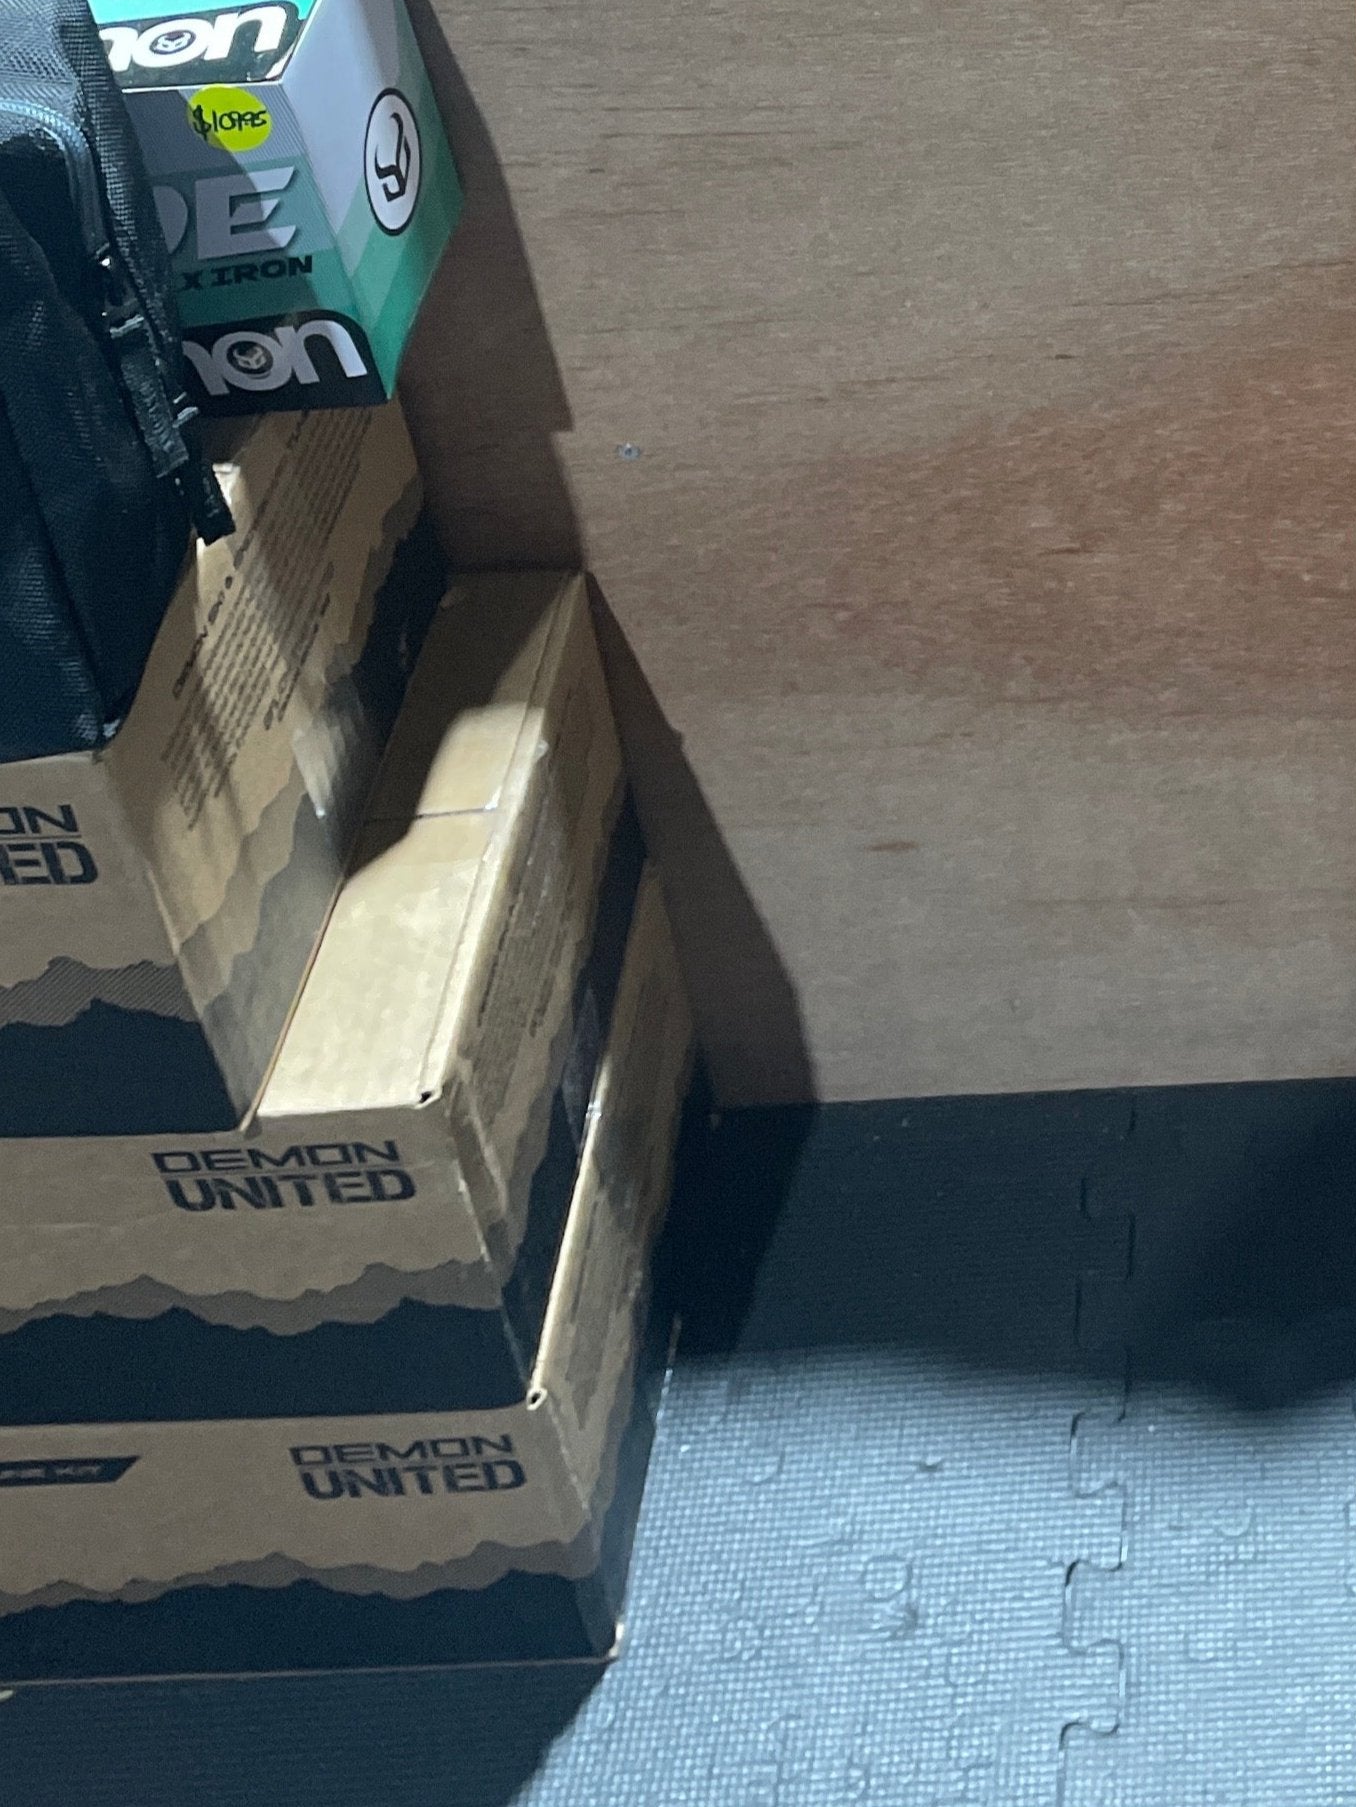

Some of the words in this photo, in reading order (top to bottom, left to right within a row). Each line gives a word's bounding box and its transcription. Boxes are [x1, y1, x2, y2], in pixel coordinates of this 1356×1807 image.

[209, 254, 313, 288] IRON
[151, 1140, 400, 1173] DEMON
[165, 1169, 416, 1212] UNITED
[289, 1434, 514, 1466] DEMON
[303, 1459, 527, 1500] UNITED
